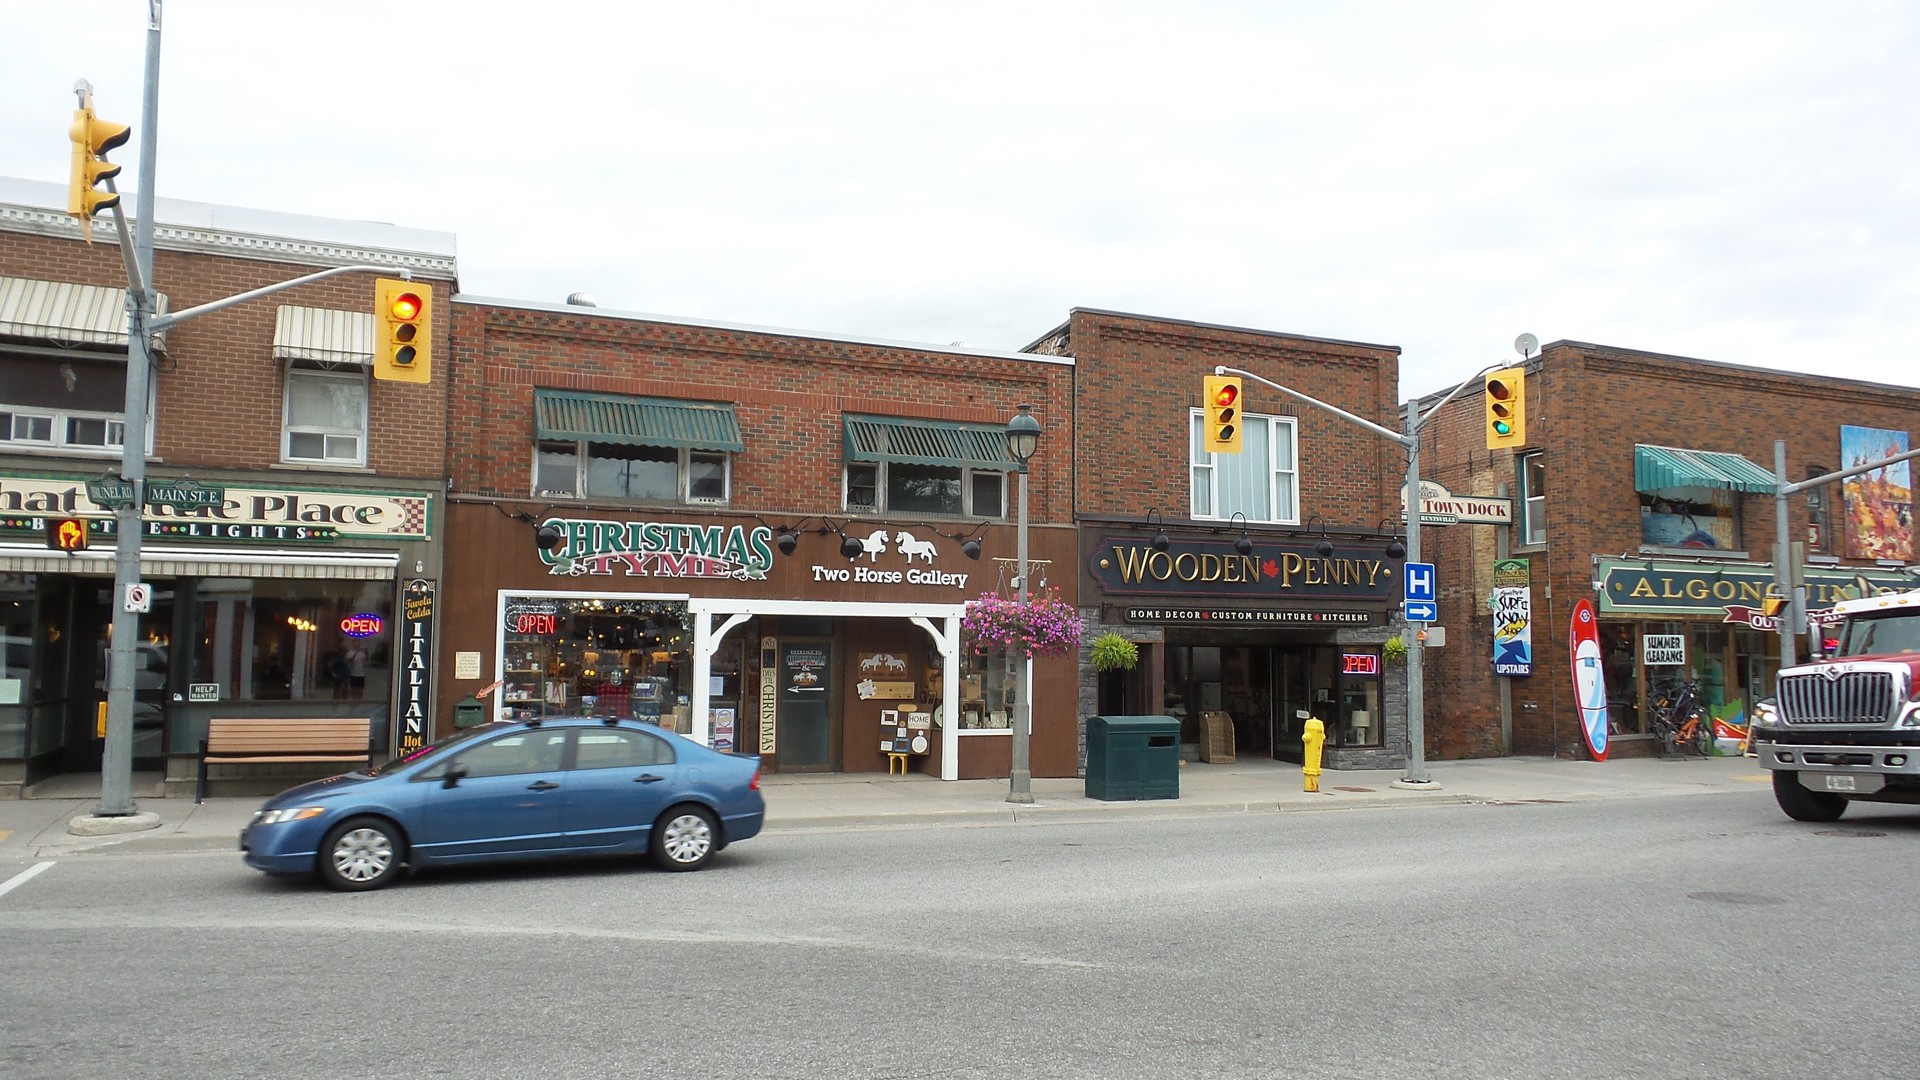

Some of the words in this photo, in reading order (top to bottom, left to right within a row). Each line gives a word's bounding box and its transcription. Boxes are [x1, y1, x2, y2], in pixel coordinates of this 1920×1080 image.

[152, 488, 187, 501] MAIN
[189, 490, 206, 502] ST.
[209, 492, 220, 503] E.
[248, 494, 383, 525] Place
[1423, 500, 1464, 515] TOWN
[1467, 502, 1507, 517] DOCK
[189, 523, 306, 539] LIGHTS
[538, 517, 773, 572] CHRISTMAS
[584, 552, 732, 579] TYME
[1112, 546, 1262, 584] WOODEN
[1279, 552, 1382, 589] PENNY
[811, 565, 850, 582] Two
[854, 567, 903, 584] Horse
[906, 569, 968, 589] Gallery
[1409, 569, 1430, 594] H
[404, 595, 433, 610] Tavola
[1498, 594, 1524, 611] SURF
[406, 606, 431, 620] Calda
[1130, 610, 1161, 619] HOME
[1165, 610, 1201, 619] DECOR
[1211, 611, 1253, 620] CUSTOM
[1256, 612, 1313, 621] FURNITURE
[1322, 613, 1368, 621] KITCHENS
[1495, 611, 1529, 628] SNOW
[341, 619, 380, 632] OPEN
[517, 614, 555, 635] OPEN
[1647, 636, 1681, 649] SUMMER
[1645, 650, 1683, 663] CLEARANCE
[404, 622, 425, 733] ITALIAN
[1496, 664, 1530, 674] UPSTAIRS
[762, 684, 775, 751] CHRISTMAS
[908, 715, 929, 724] HOME
[403, 735, 422, 747] Hot
